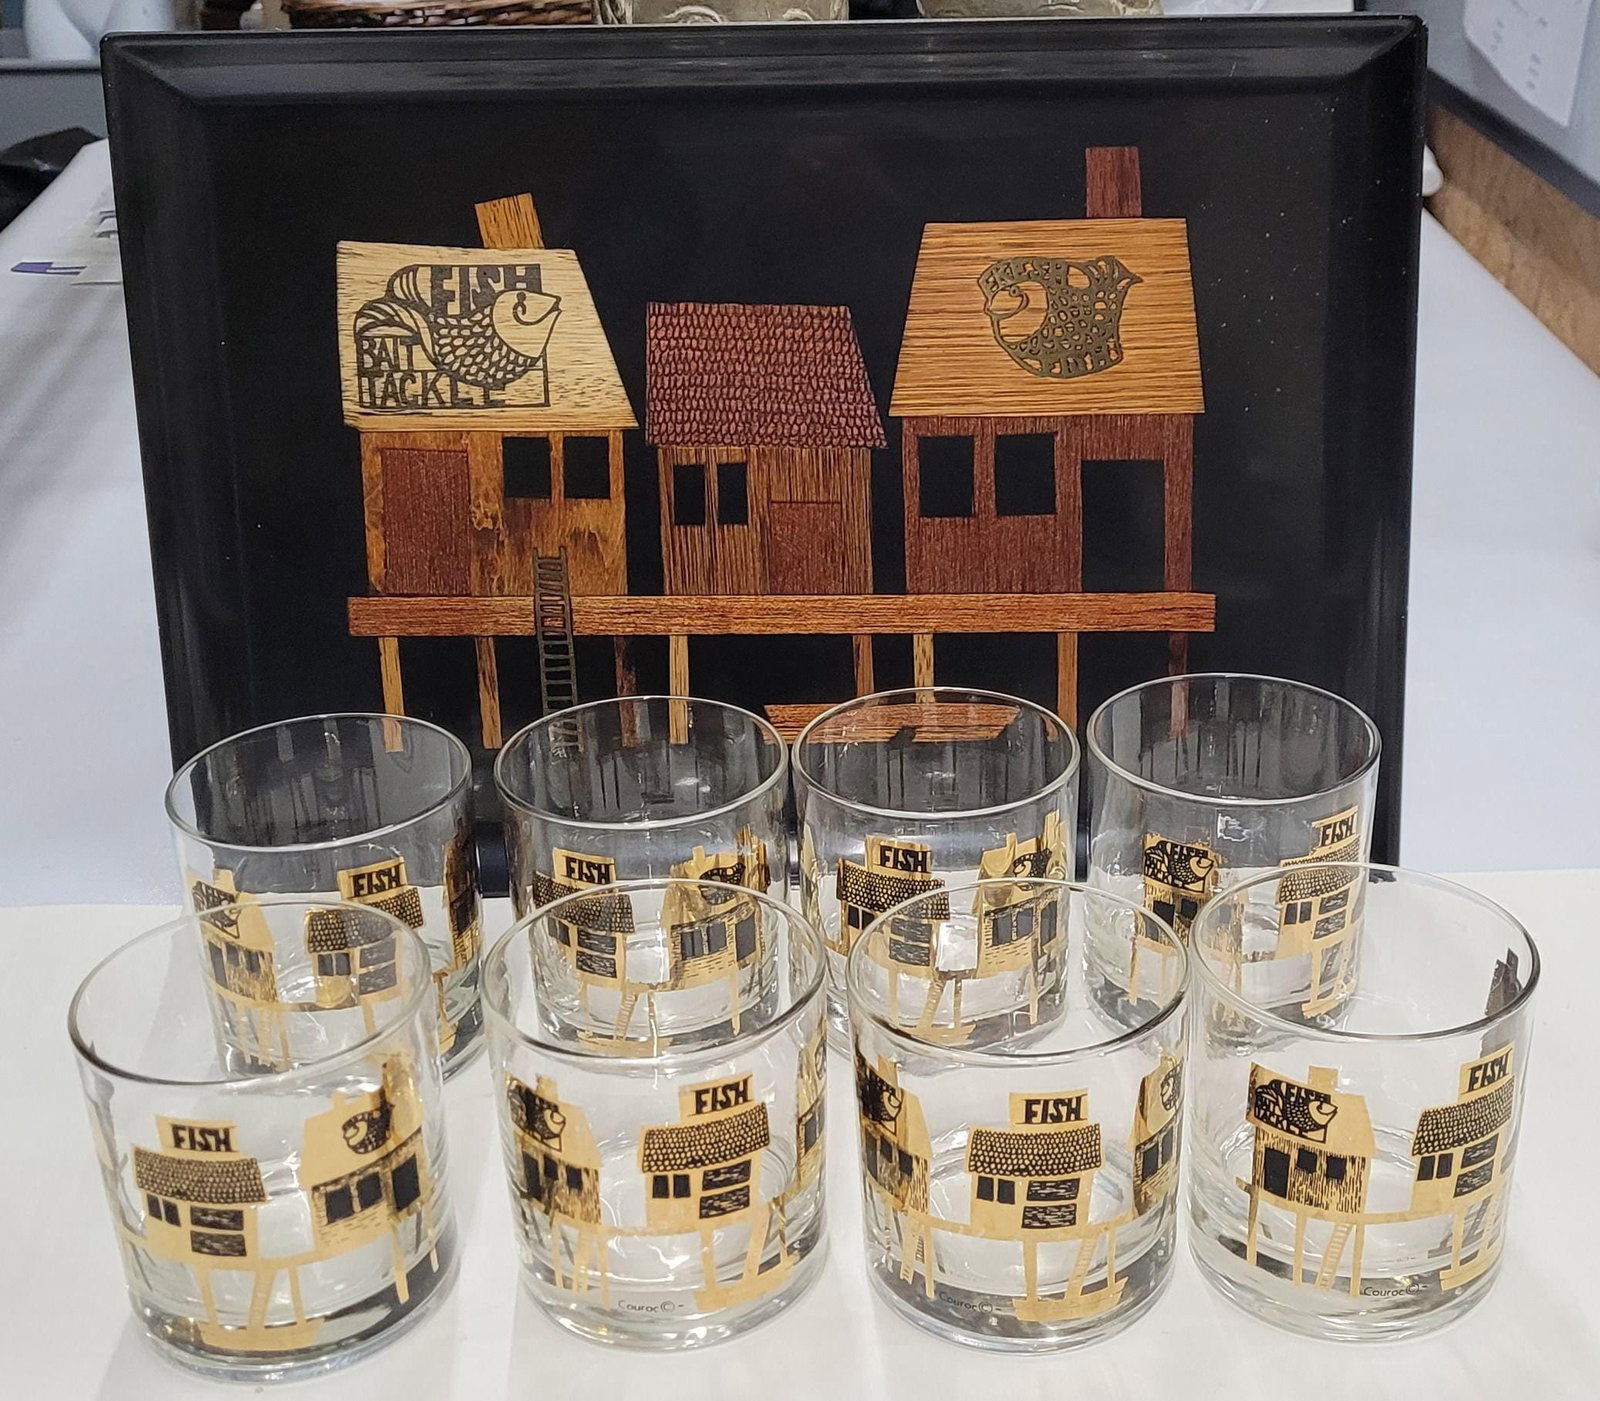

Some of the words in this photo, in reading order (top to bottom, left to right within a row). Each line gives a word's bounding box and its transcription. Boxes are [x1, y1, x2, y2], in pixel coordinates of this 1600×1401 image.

[431, 265, 542, 316] FISH
[358, 336, 419, 370] BAIT
[1322, 821, 1354, 847] FISH
[566, 857, 613, 884] FISH
[879, 845, 928, 872] FISH
[354, 865, 397, 897] FISH
[1468, 1059, 1511, 1091] FISH
[696, 1081, 750, 1114] FISH
[1025, 1097, 1081, 1124] FISH
[173, 1125, 234, 1152] FISH
